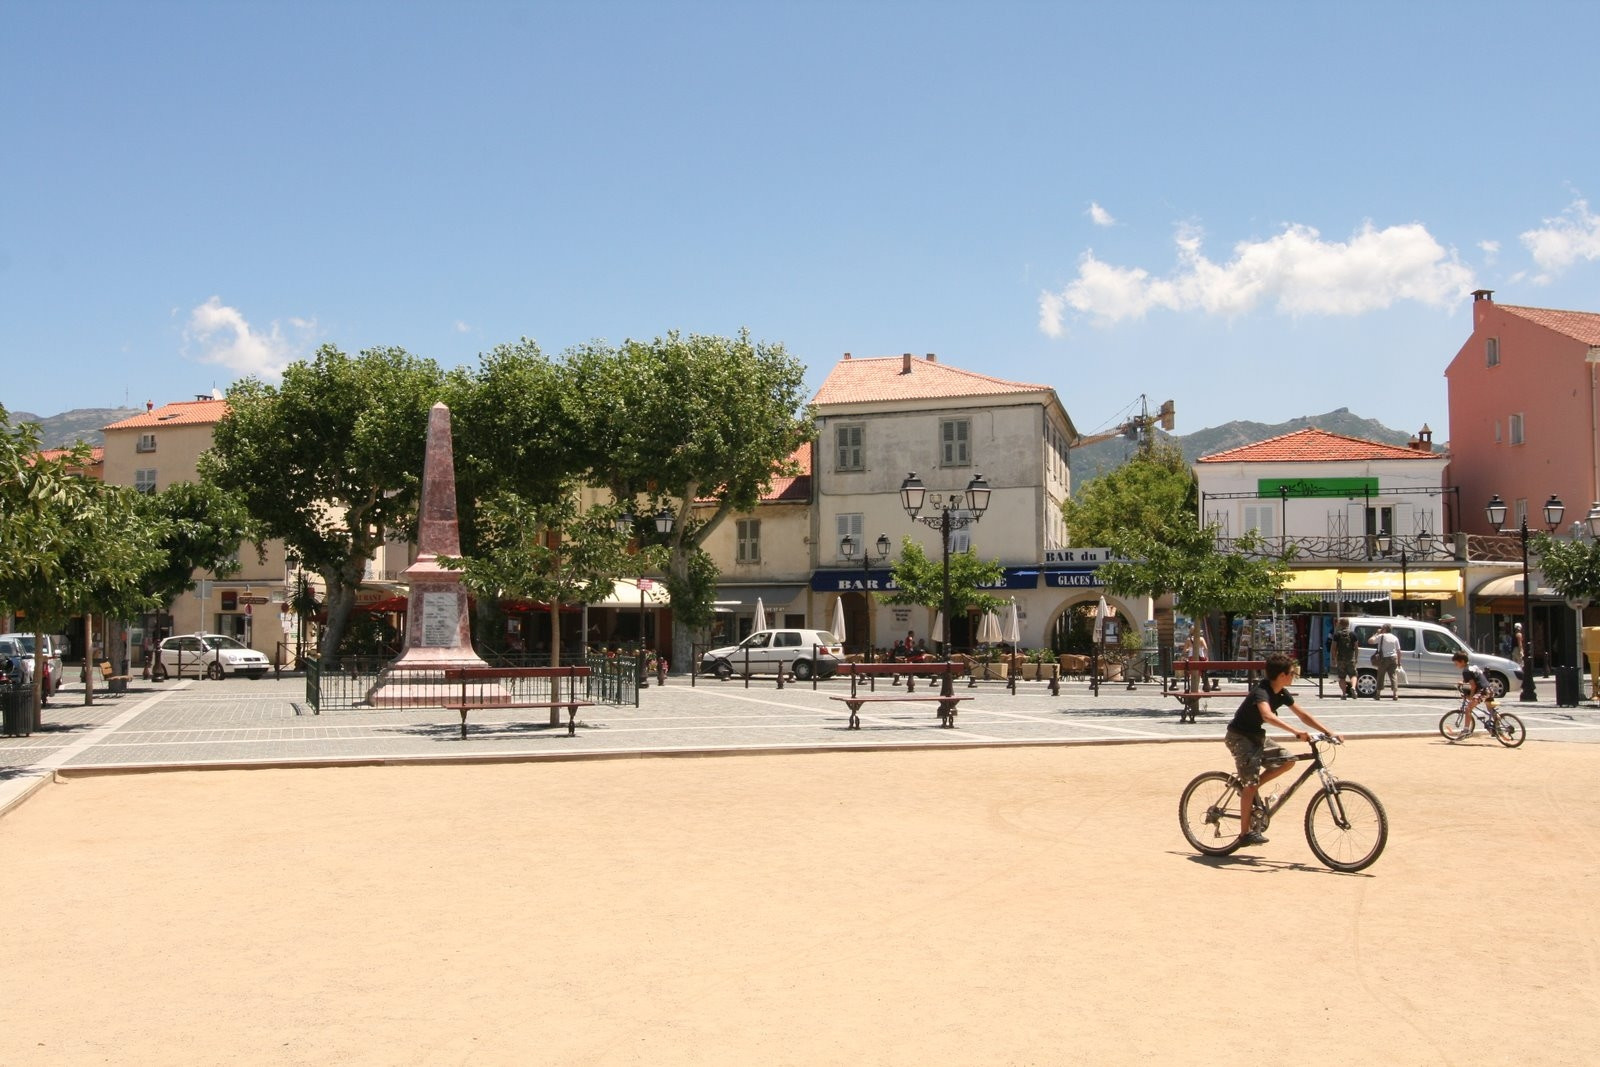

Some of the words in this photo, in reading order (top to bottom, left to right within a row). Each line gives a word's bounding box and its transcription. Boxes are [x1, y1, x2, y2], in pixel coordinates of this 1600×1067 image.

[1046, 551, 1074, 561] BAR
[1081, 551, 1097, 561] du
[838, 580, 879, 589] BAR
[1058, 575, 1090, 585] GLACES
